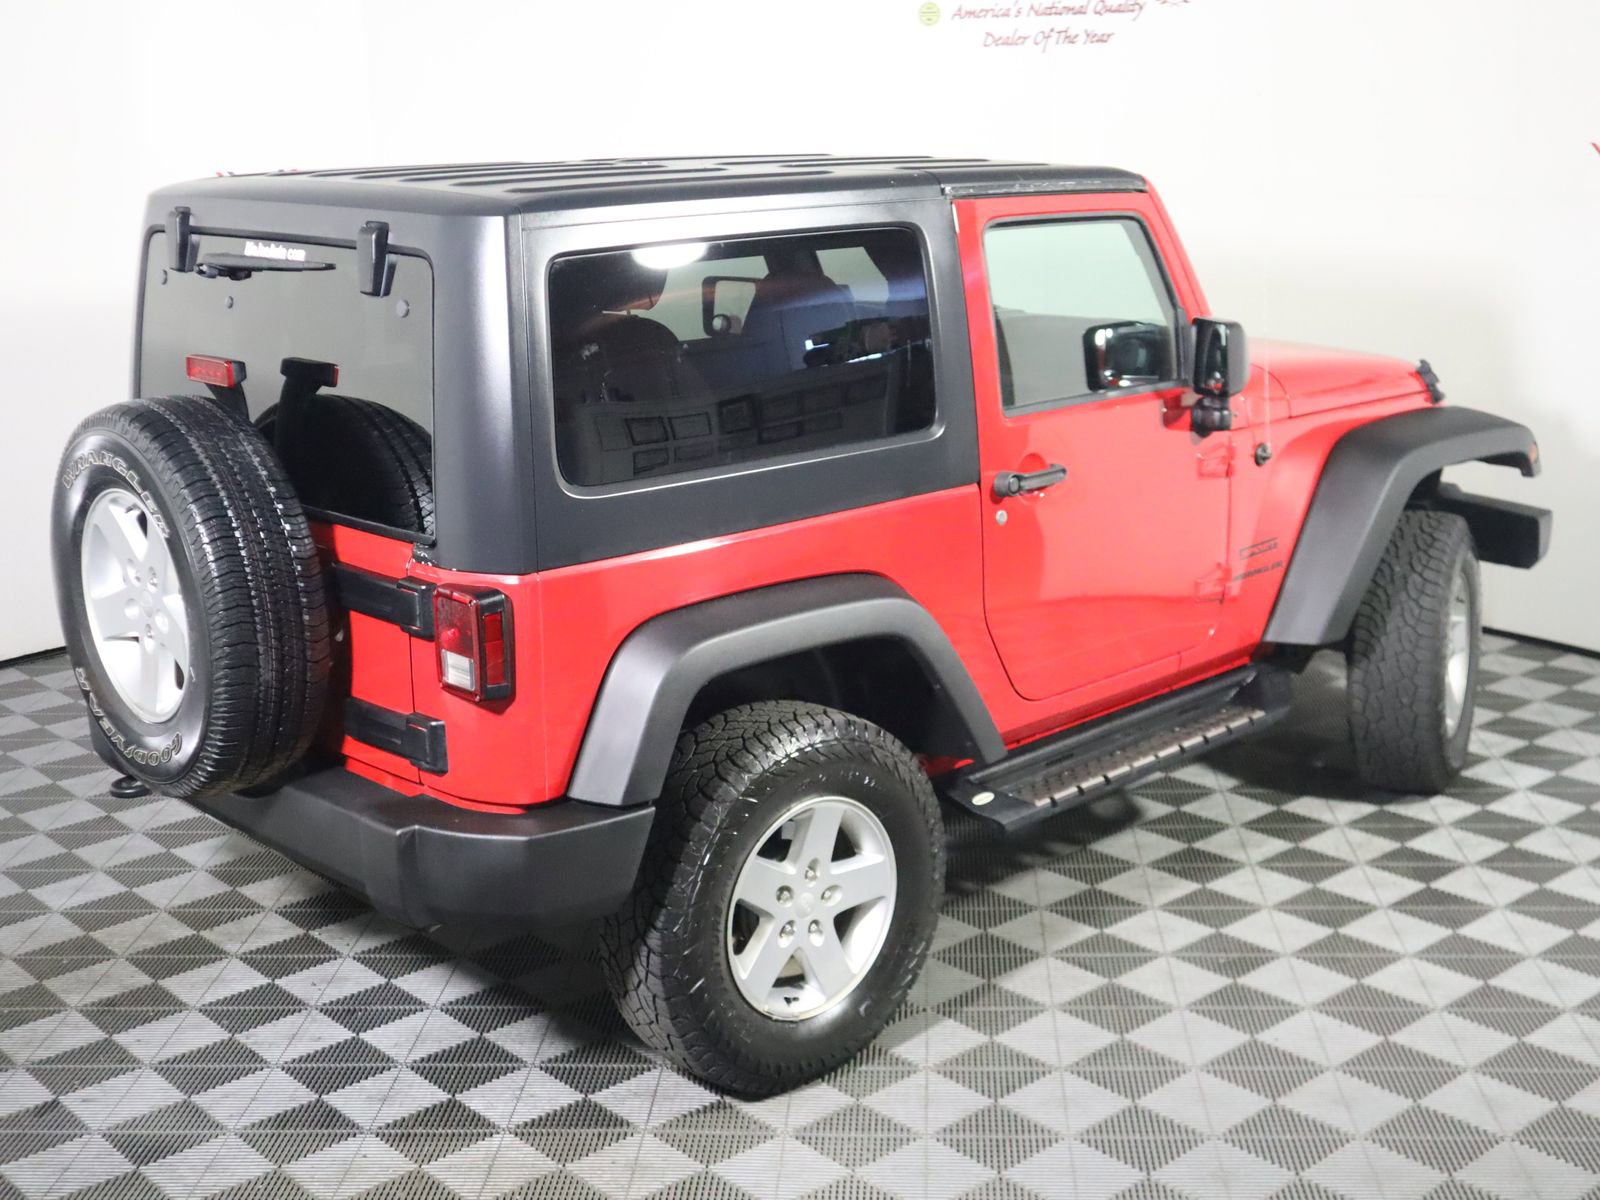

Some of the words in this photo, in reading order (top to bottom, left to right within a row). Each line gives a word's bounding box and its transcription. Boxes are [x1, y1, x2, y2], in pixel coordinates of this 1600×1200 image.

[952, 2, 1022, 20] America's
[1027, 1, 1088, 18] National
[1093, 0, 1146, 21] Quality
[983, 29, 1030, 47] Dealer
[1033, 28, 1055, 53] Of
[1056, 27, 1078, 45] The
[1083, 29, 1115, 45] Year
[63, 450, 170, 538] WRANGLER
[75, 667, 182, 766] GOODYEAR
